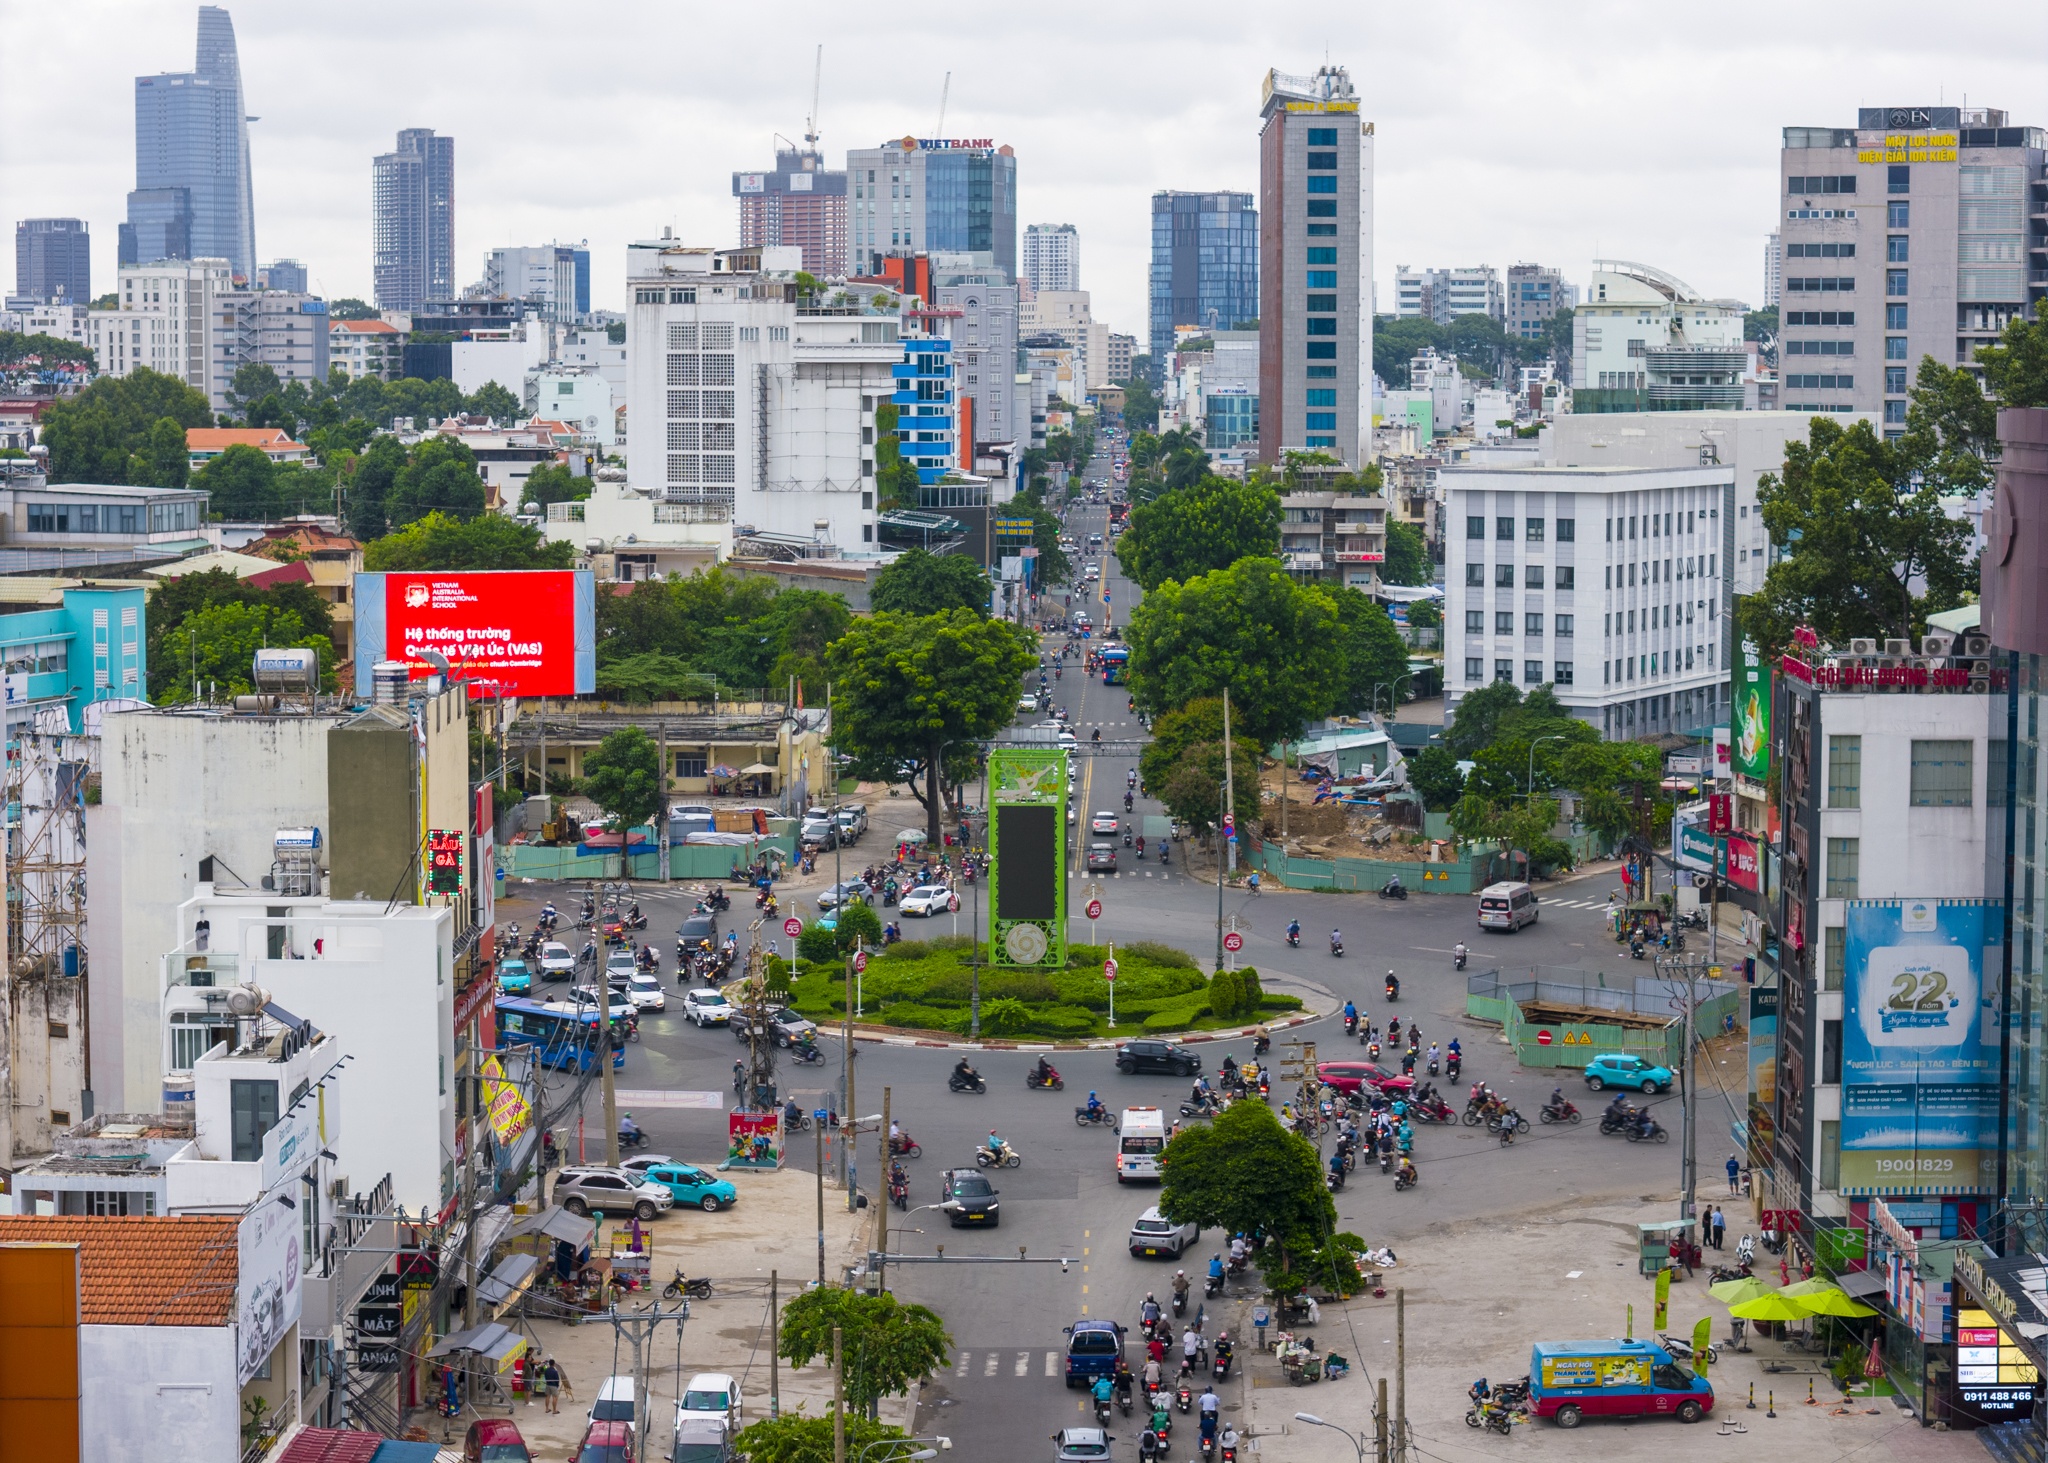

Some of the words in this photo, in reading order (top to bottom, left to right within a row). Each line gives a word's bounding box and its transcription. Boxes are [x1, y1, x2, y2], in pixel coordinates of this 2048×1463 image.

[1286, 102, 1315, 112] NAM
[1326, 102, 1359, 112] BANK
[919, 138, 994, 149] VIETBANK
[1909, 136, 1928, 149] LỌC
[1930, 134, 1957, 147] NƯỚC
[1858, 150, 1883, 165] ĐIỆN
[1909, 152, 1928, 162] ION
[405, 628, 424, 642] Hệ
[426, 628, 464, 642] thống
[467, 627, 512, 641] trường
[487, 641, 504, 656] Úc
[507, 642, 543, 657] (VAS)
[510, 659, 542, 668] Cambridge
[1816, 664, 1840, 688] GỘI
[1845, 660, 1874, 686] ĐẦU
[1878, 663, 1928, 686] DƯỠNG
[1932, 668, 1968, 686] SINH
[432, 834, 459, 851] LẨU
[436, 852, 456, 867] GÀ
[1090, 907, 1100, 916] 5G
[786, 924, 800, 934] 5G
[1226, 939, 1240, 948] 5G
[857, 959, 867, 970] 5G
[1106, 966, 1114, 977] 5G
[1888, 971, 1948, 1011] 22
[1876, 1159, 1954, 1172] 19001829
[1986, 1276, 2017, 1321] GROUP
[364, 1314, 394, 1331] MẮT
[361, 1352, 398, 1364] ANNA
[1556, 1361, 1578, 1369] NGÀY
[1964, 1392, 1987, 1400] 0911
[1990, 1392, 2009, 1400] 488
[2011, 1392, 2031, 1400] 466
